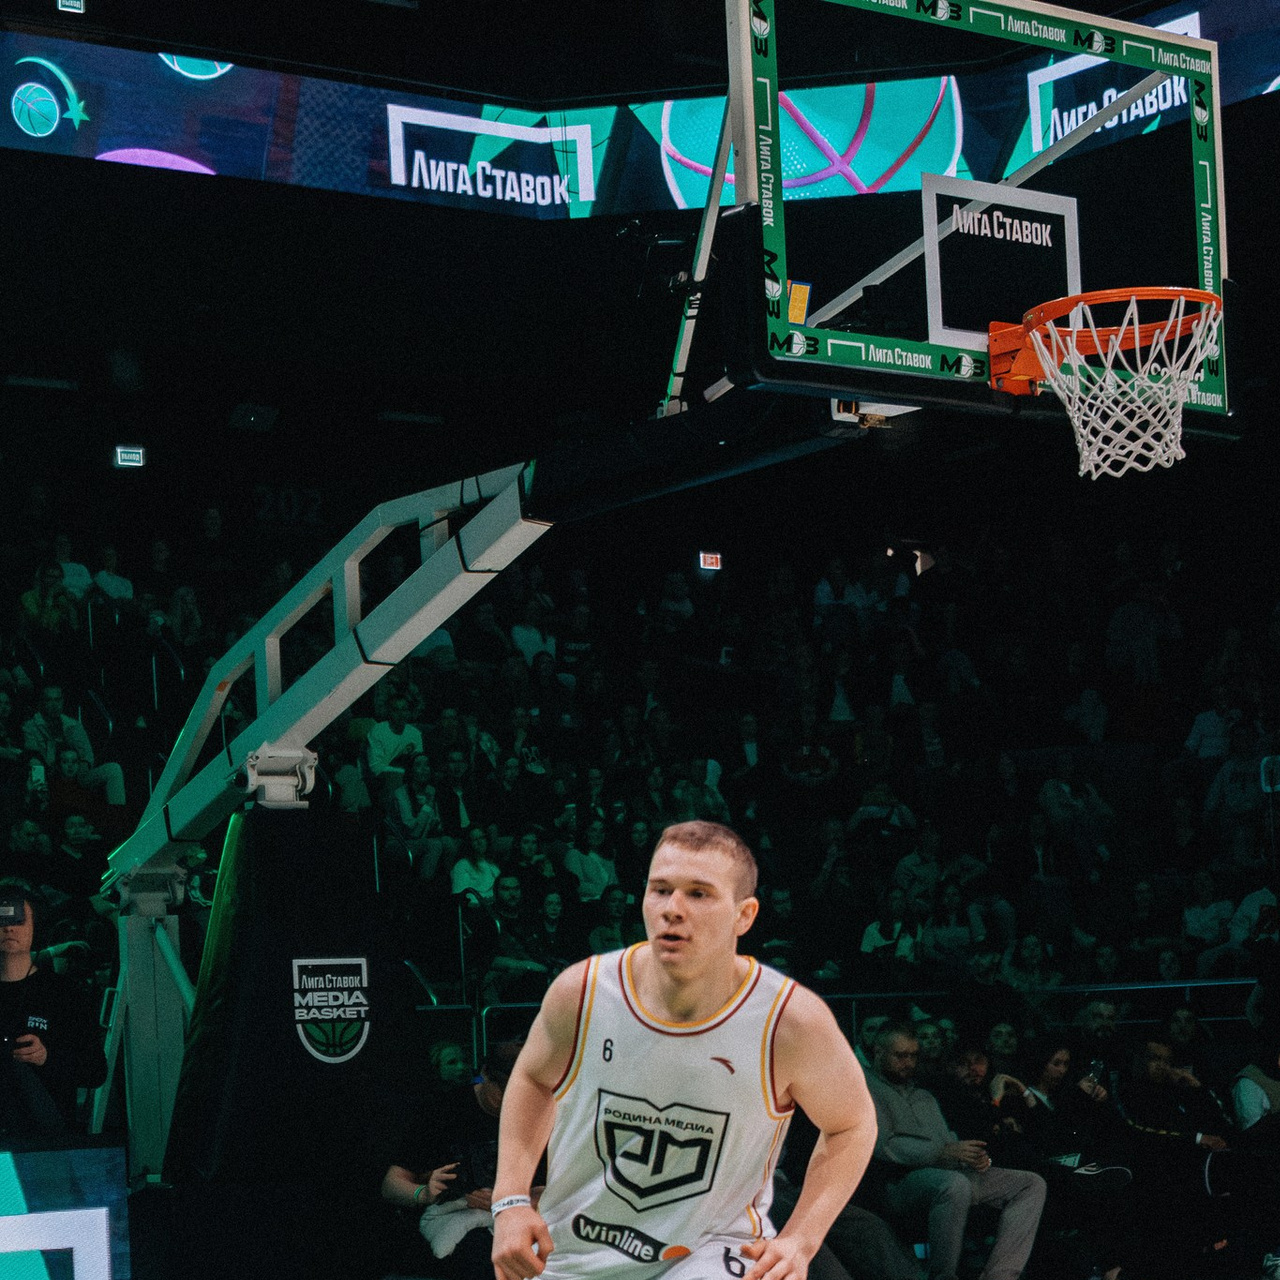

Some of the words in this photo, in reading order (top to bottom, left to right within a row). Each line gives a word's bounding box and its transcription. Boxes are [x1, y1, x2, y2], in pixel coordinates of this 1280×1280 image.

[411, 150, 473, 196] ЛИГА
[476, 160, 571, 206] СТАВОК
[952, 204, 991, 238] ЛИГА
[993, 211, 1052, 247] СТАВОК
[294, 990, 368, 1007] MEDIA
[295, 1006, 370, 1020] BASKET
[602, 1038, 613, 1062] 6
[604, 1107, 662, 1125] РОДИНА
[664, 1117, 714, 1134] МЕДИА
[579, 1218, 654, 1260] winline
[723, 1246, 746, 1279] 6
